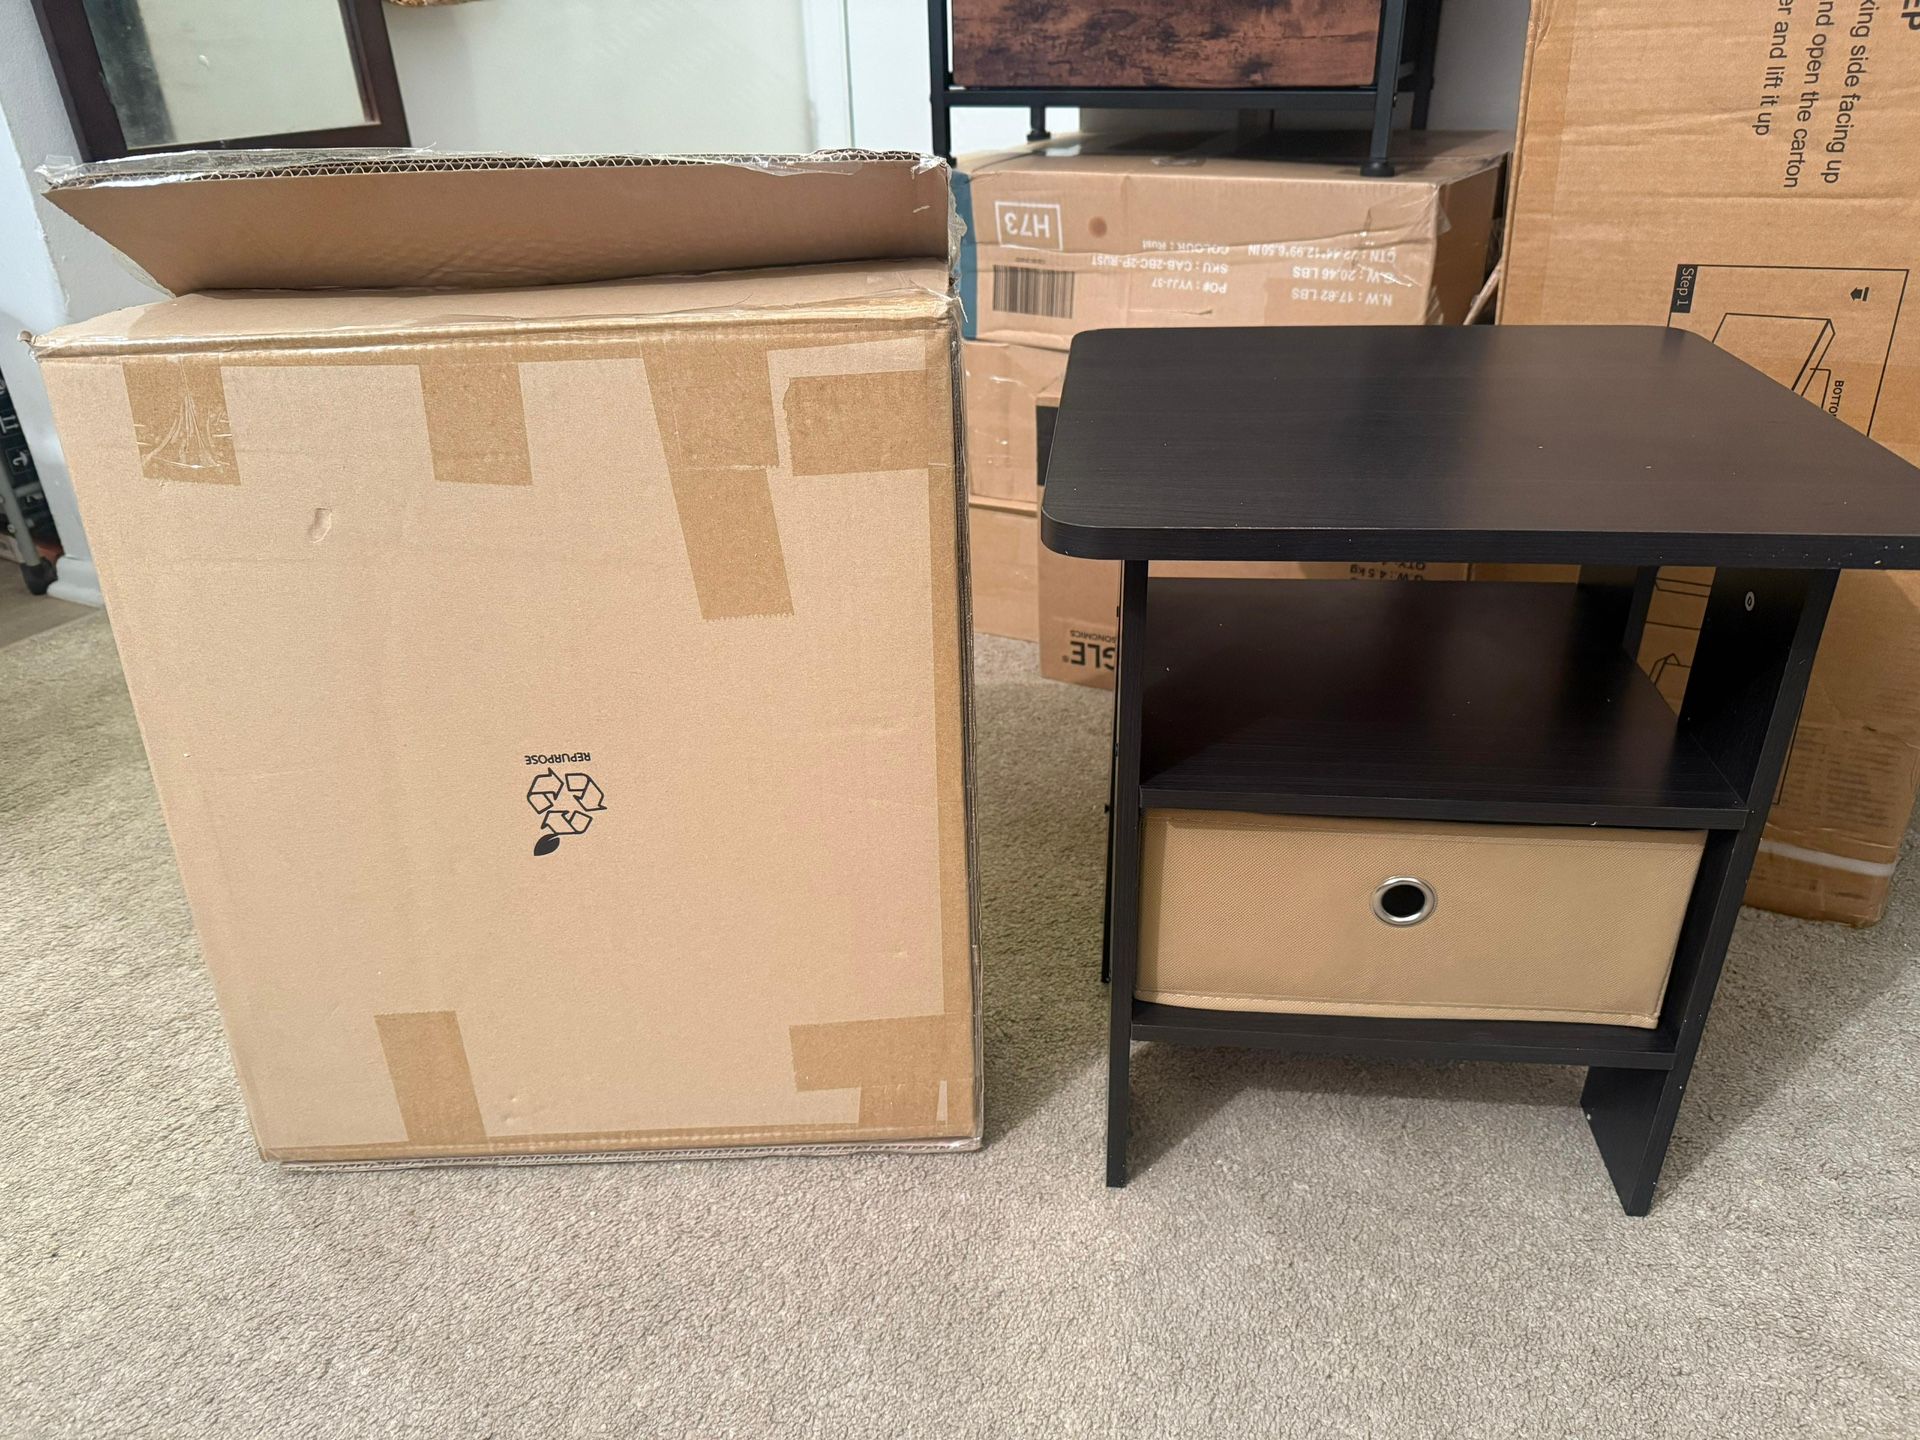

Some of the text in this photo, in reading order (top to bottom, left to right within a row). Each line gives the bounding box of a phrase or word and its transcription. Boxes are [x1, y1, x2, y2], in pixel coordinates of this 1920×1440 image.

[1769, 21, 1789, 59] and
[1804, 33, 1827, 85] open
[1844, 45, 1868, 87] side
[1763, 66, 1786, 89] lift
[1760, 95, 1780, 107] it
[1797, 91, 1819, 122] the
[1752, 112, 1772, 136] up
[1826, 93, 1861, 153] facing
[1783, 128, 1808, 188] carton
[1821, 160, 1842, 184] up
[1004, 212, 1050, 239] H73
[1202, 262, 1229, 274] SKU
[1292, 266, 1318, 279] LBS
[1676, 267, 1694, 295] Step
[1291, 288, 1317, 300] LBS
[1828, 380, 1845, 416] BOTTO
[524, 752, 592, 765] REPURPOSE
